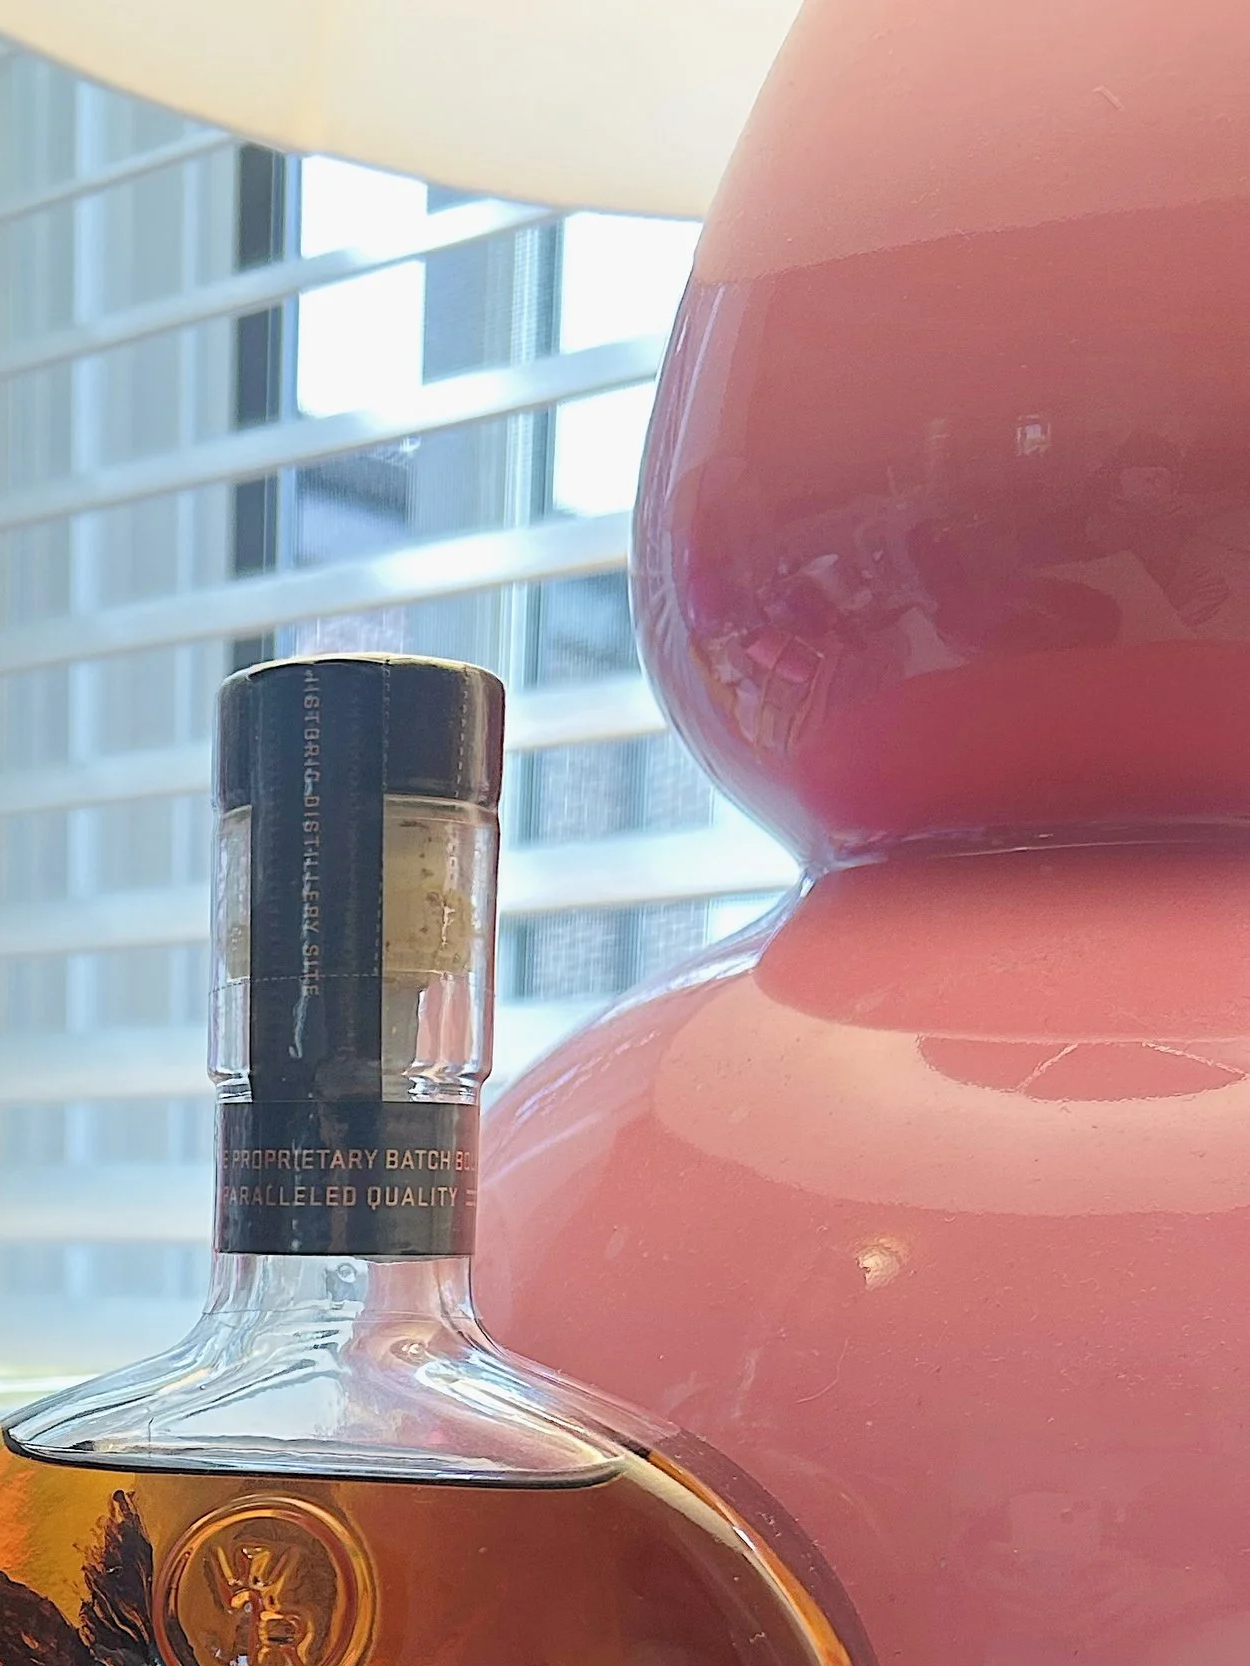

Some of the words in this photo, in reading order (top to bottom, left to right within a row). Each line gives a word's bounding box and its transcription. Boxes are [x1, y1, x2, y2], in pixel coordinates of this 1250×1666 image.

[303, 796, 320, 933] DISTILLERY
[303, 945, 320, 997] SITE
[232, 1149, 378, 1171] PROPRIETARY
[385, 1149, 451, 1171] BATCH
[367, 1186, 458, 1210] QUALITY
